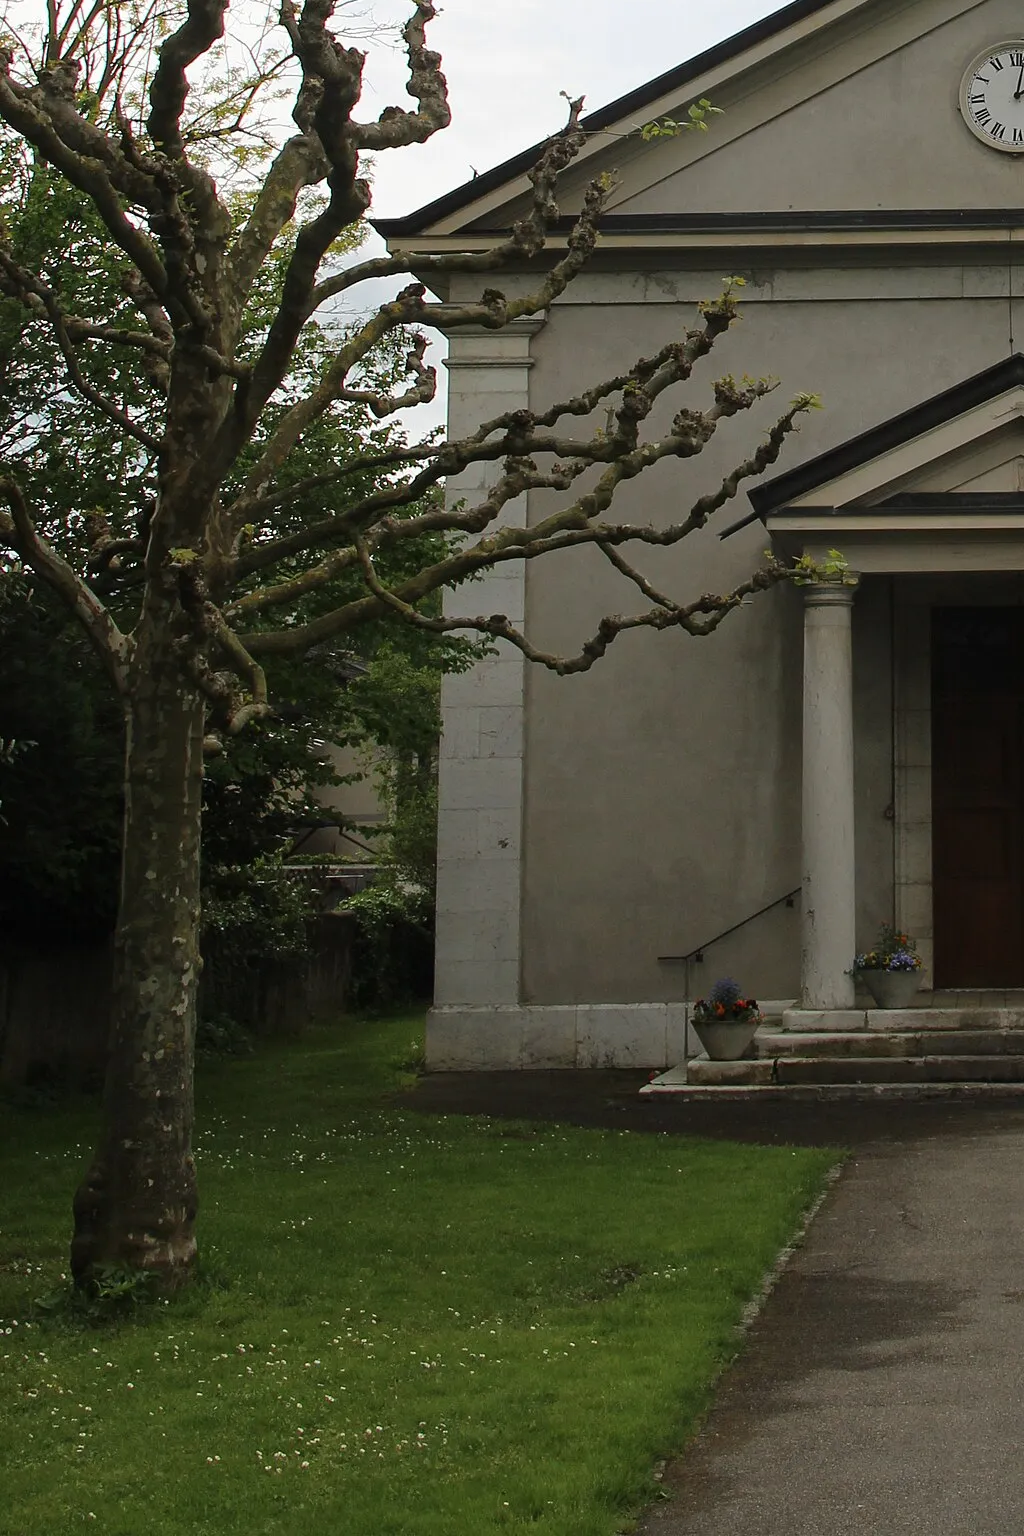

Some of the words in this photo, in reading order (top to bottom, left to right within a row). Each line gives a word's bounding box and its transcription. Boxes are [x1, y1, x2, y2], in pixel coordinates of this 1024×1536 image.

[975, 108, 992, 126] VIII
[990, 122, 1006, 138] VII
[1012, 128, 1023, 141] VI
